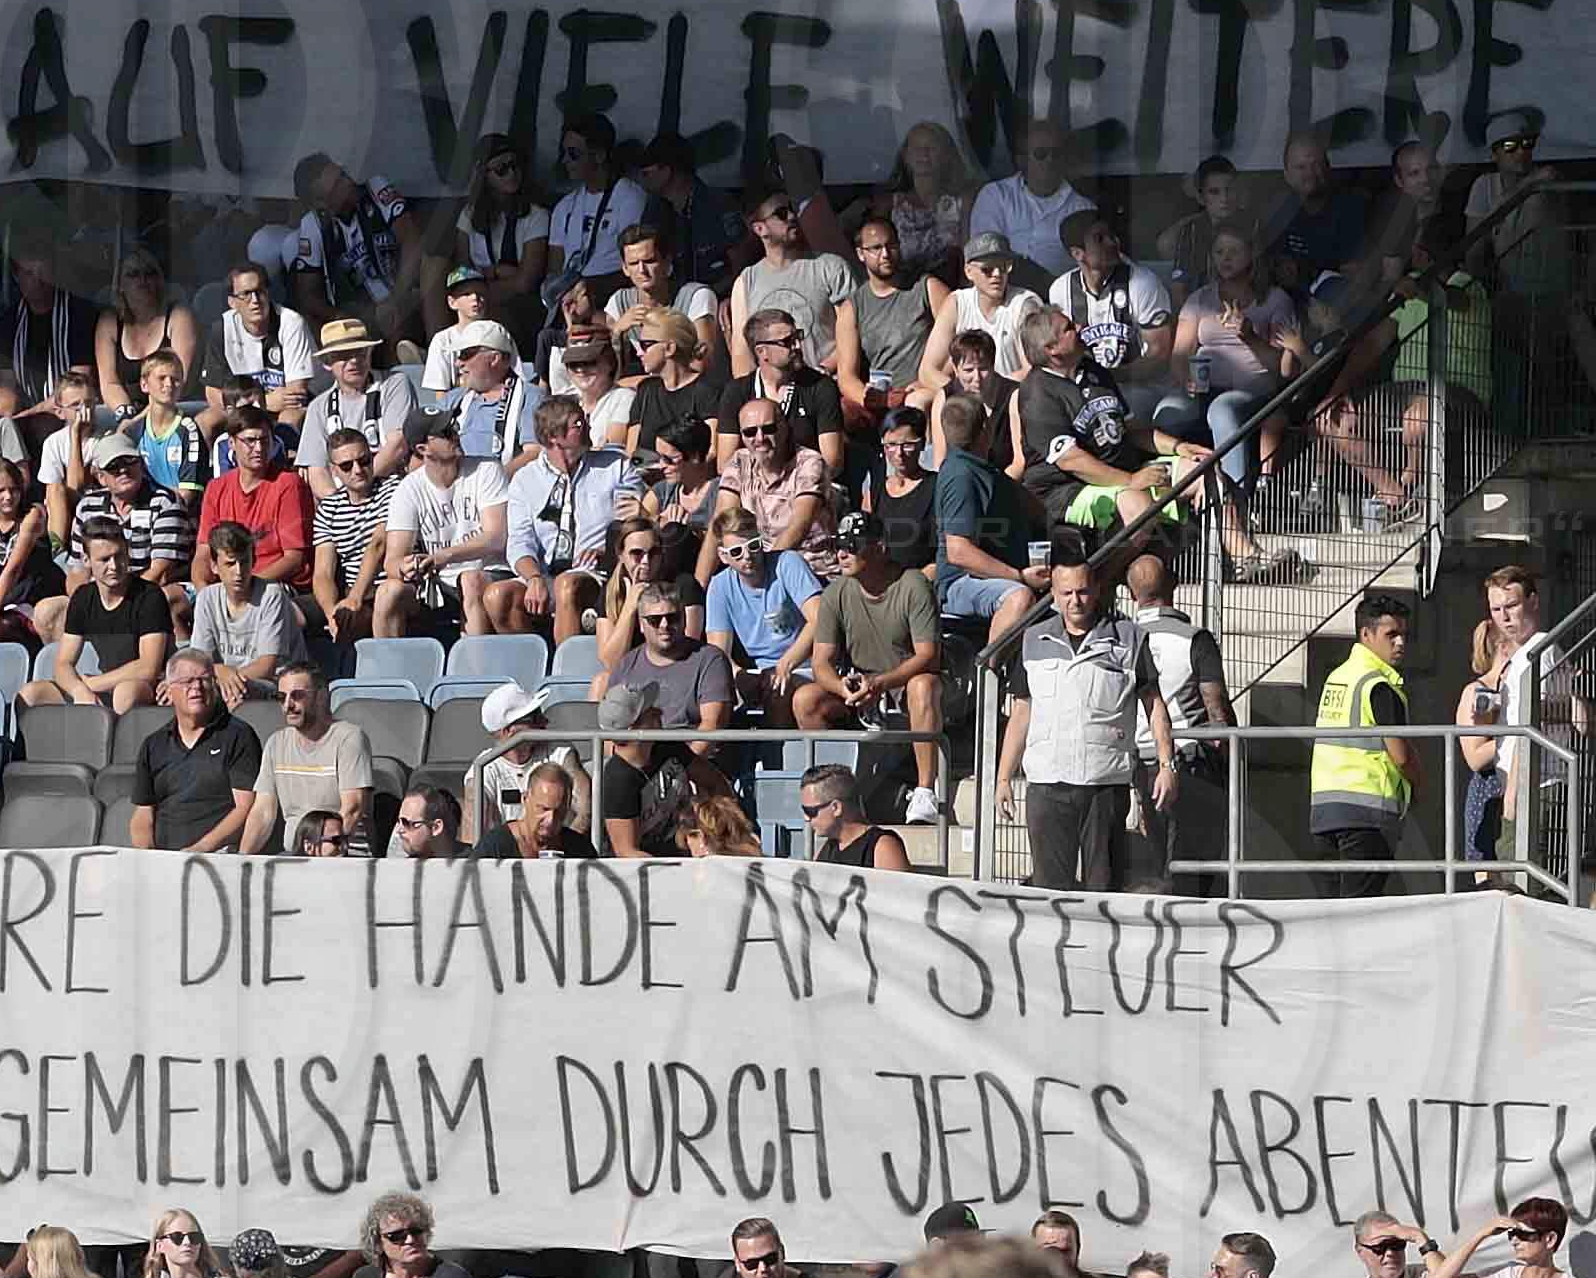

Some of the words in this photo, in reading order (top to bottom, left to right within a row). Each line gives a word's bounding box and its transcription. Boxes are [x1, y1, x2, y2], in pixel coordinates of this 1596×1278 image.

[8, 8, 300, 175] AUF
[405, 8, 833, 191] VIELE
[180, 855, 305, 987] DIE
[724, 860, 879, 1004] AM
[926, 884, 1286, 1028] STEUER
[555, 1054, 833, 1203] DURCH
[874, 1067, 1152, 1229] JEDES
